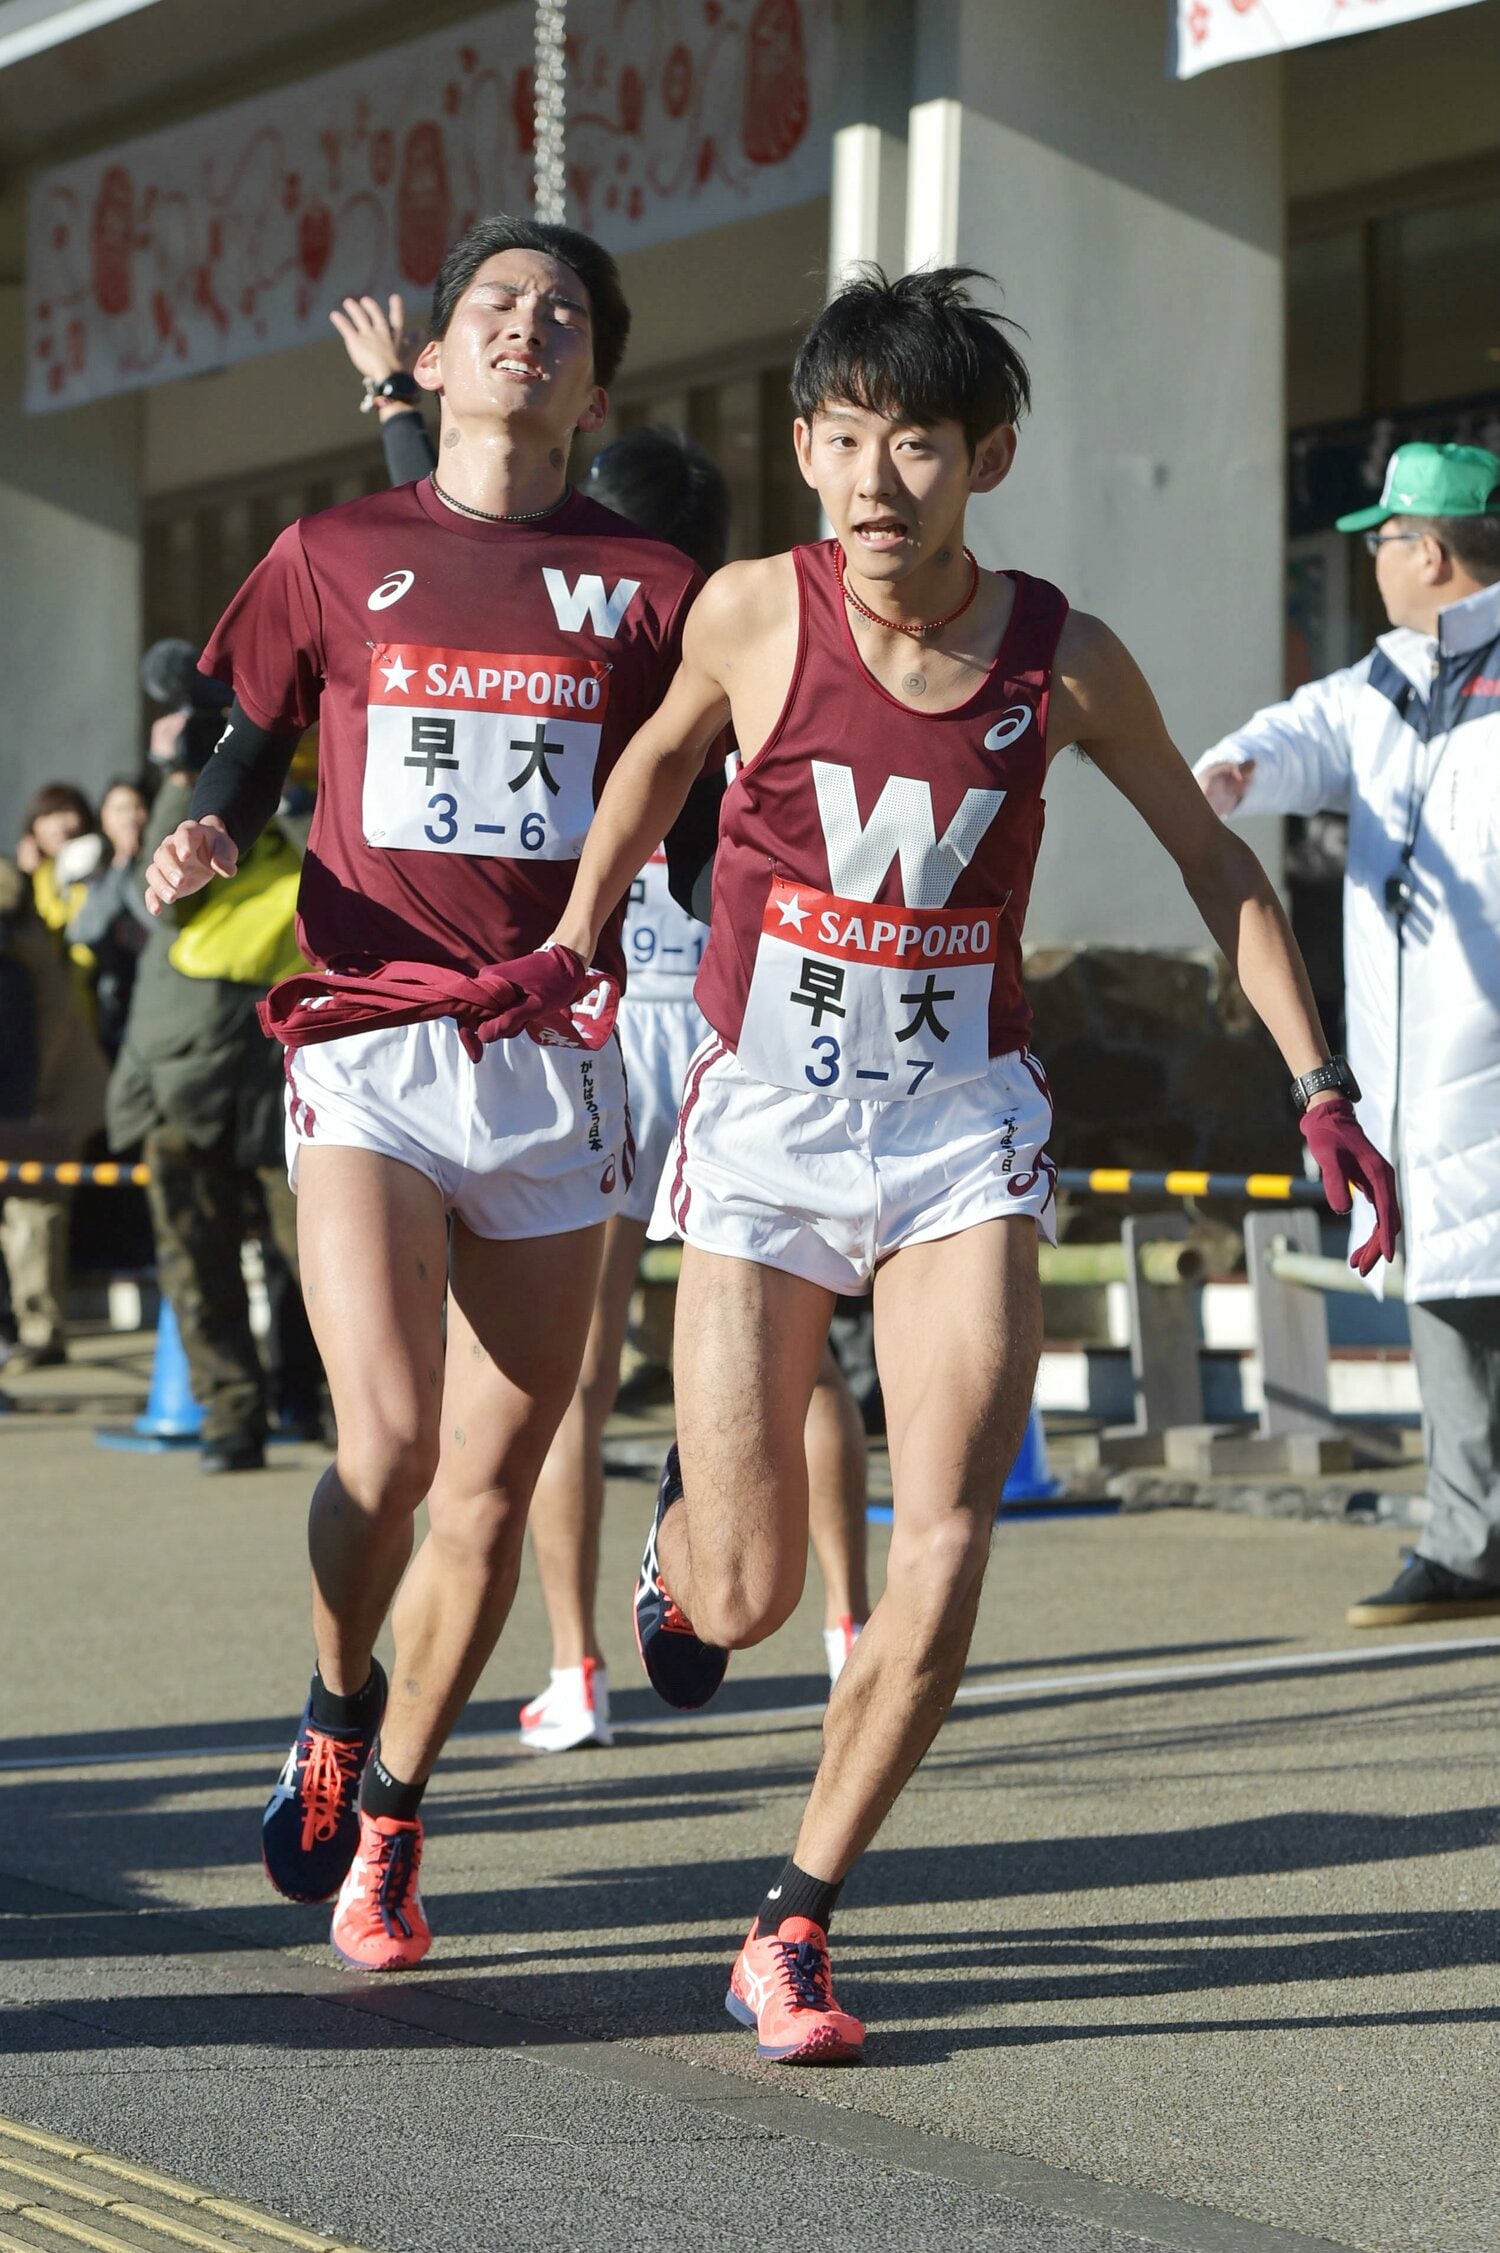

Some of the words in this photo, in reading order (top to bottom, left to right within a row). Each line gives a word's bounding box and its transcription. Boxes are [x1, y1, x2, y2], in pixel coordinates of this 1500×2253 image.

[541, 566, 641, 639] W
[425, 662, 600, 710] SAPPORO
[810, 759, 1008, 909] W
[817, 911, 990, 958] SAPPORO
[580, 1059, 603, 1152] がんばろう日本
